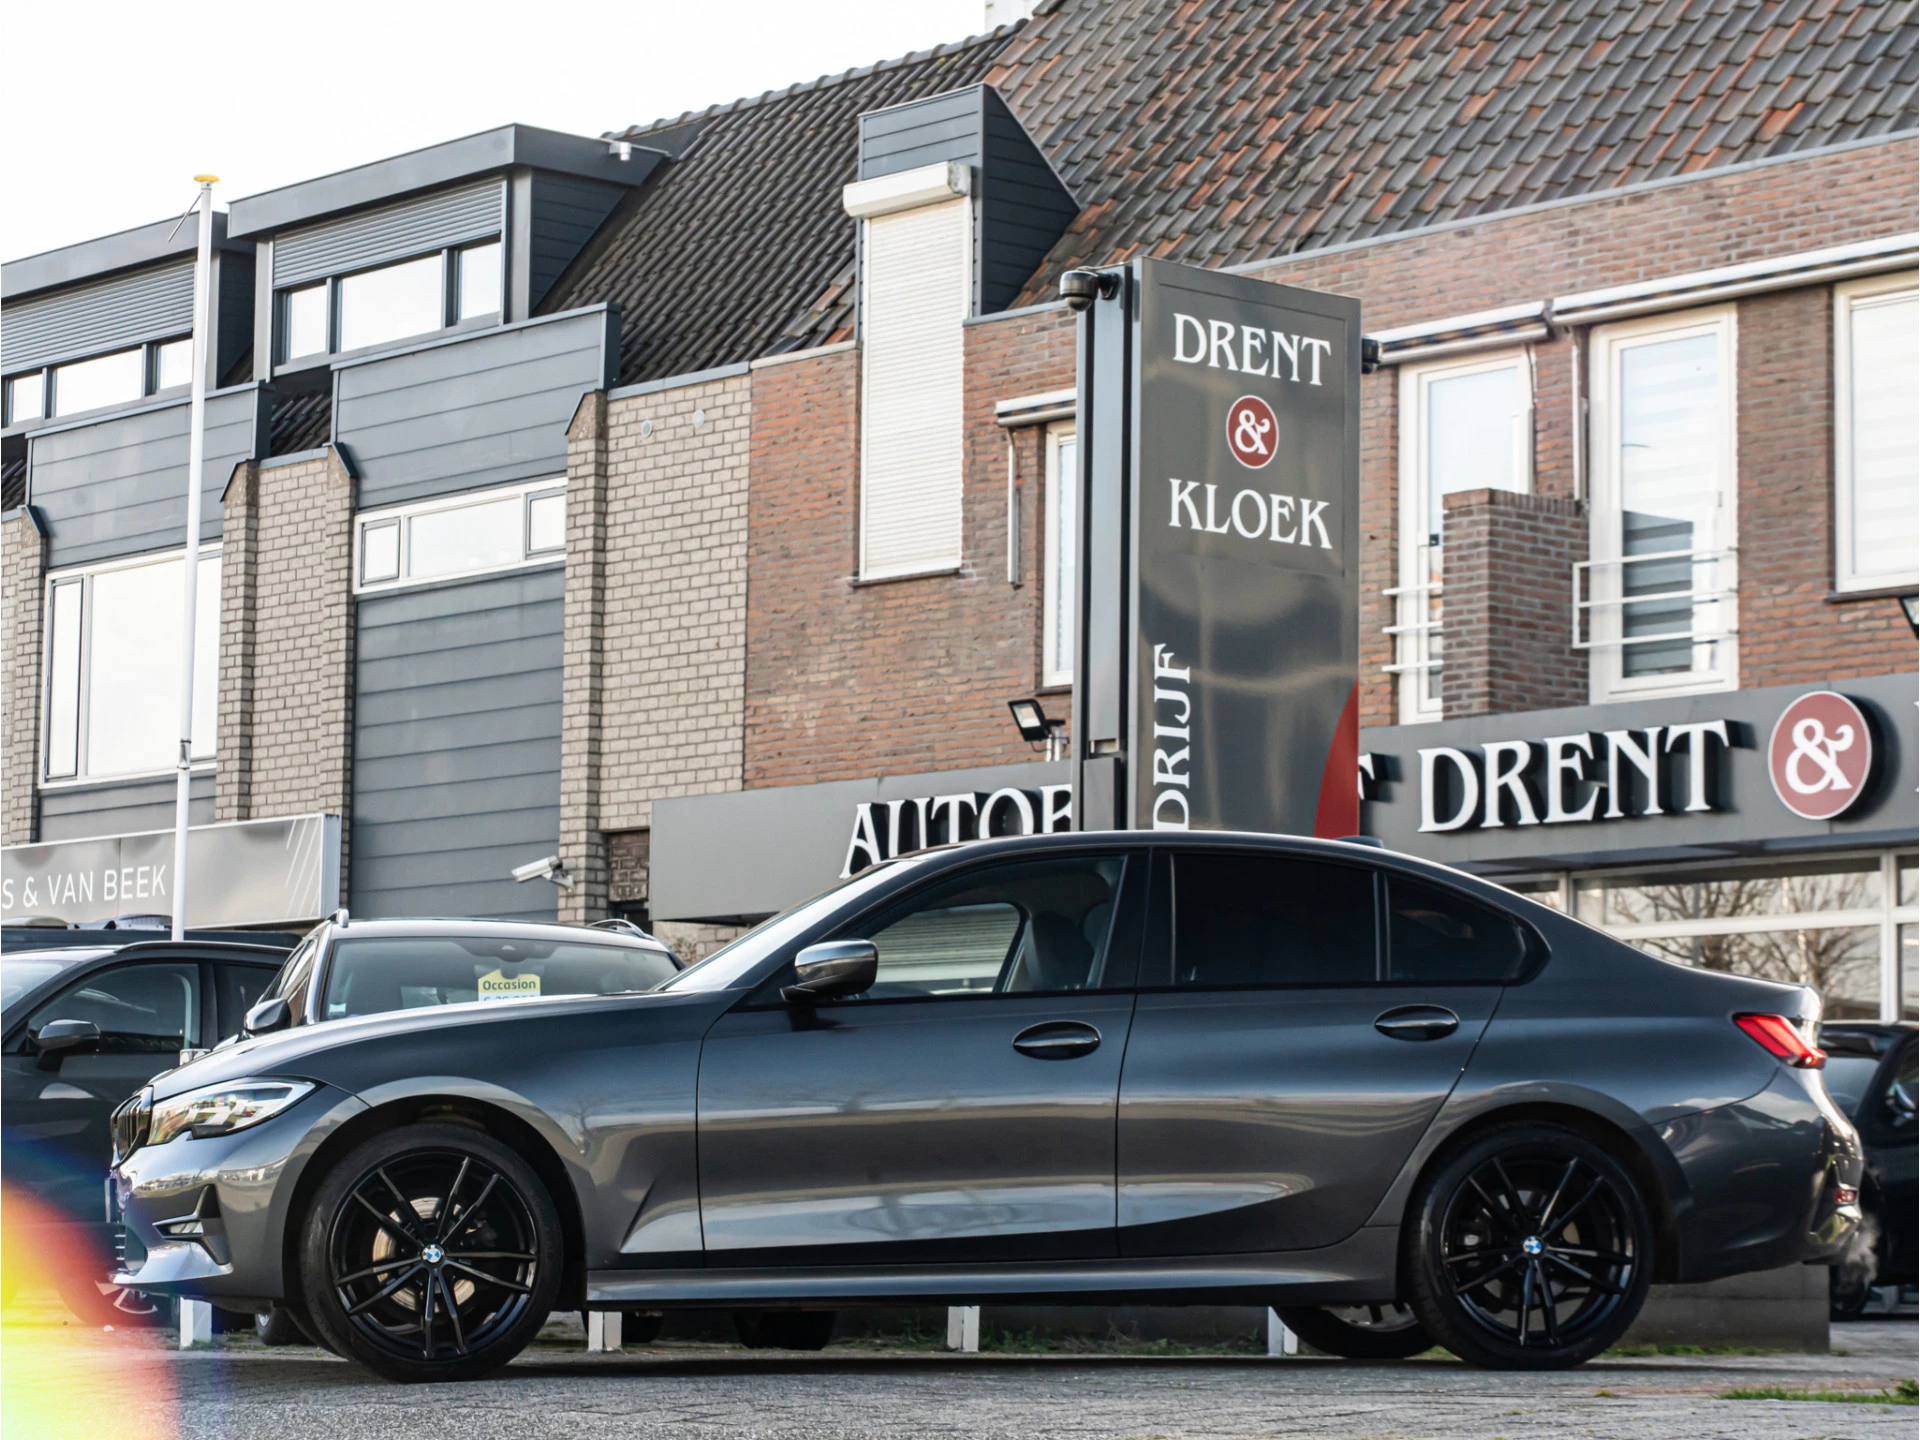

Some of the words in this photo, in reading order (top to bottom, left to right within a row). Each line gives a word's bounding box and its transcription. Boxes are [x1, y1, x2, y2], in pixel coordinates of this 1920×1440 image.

[1173, 313, 1331, 386] DRENT
[1234, 409, 1271, 455] &
[1168, 478, 1333, 549] KLOEK
[1153, 643, 1191, 830] DRIJF
[1417, 719, 1729, 832] DRENT
[1785, 718, 1855, 795] &
[2, 878, 14, 909] S
[23, 876, 38, 908] &
[48, 871, 94, 905] VAN
[103, 864, 166, 901] BEEK
[482, 979, 536, 990] Occasion
